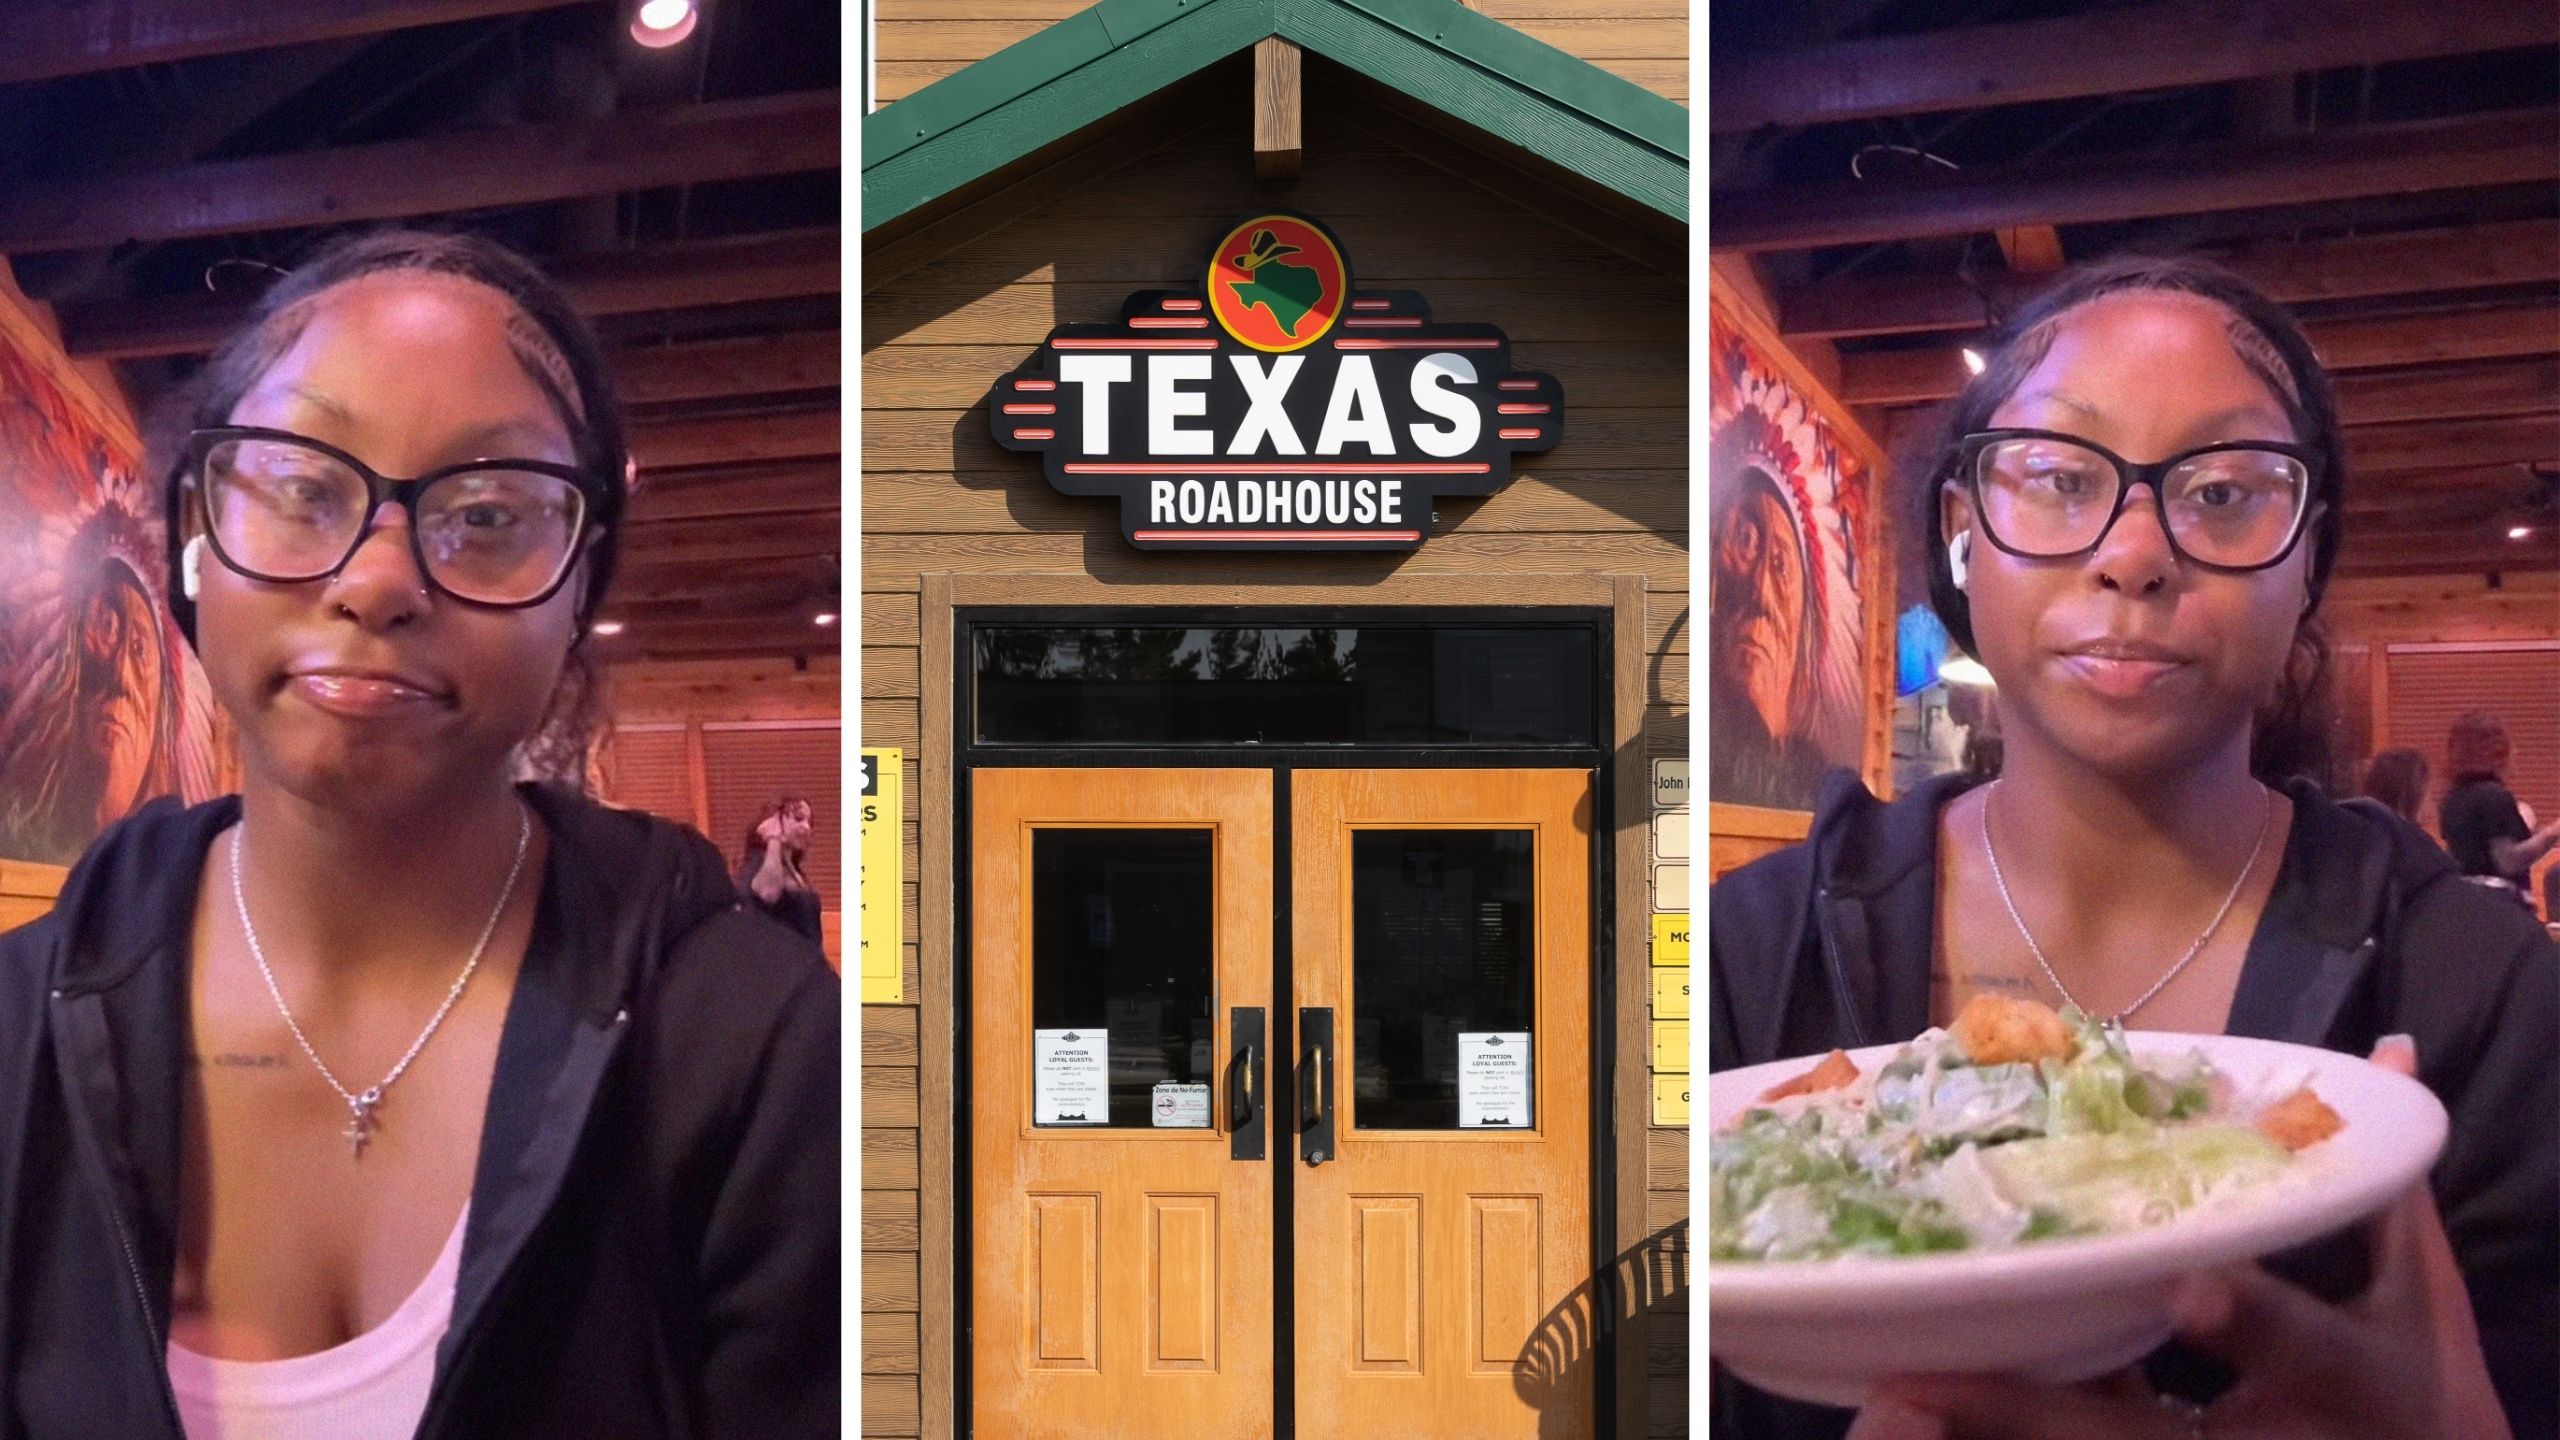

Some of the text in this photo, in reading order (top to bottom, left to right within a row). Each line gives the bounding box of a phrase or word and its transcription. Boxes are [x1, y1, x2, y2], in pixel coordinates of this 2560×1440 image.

[1059, 352, 1482, 458] TEXAS
[1150, 479, 1403, 524] ROADHOUSE
[1659, 776, 1684, 789] John
